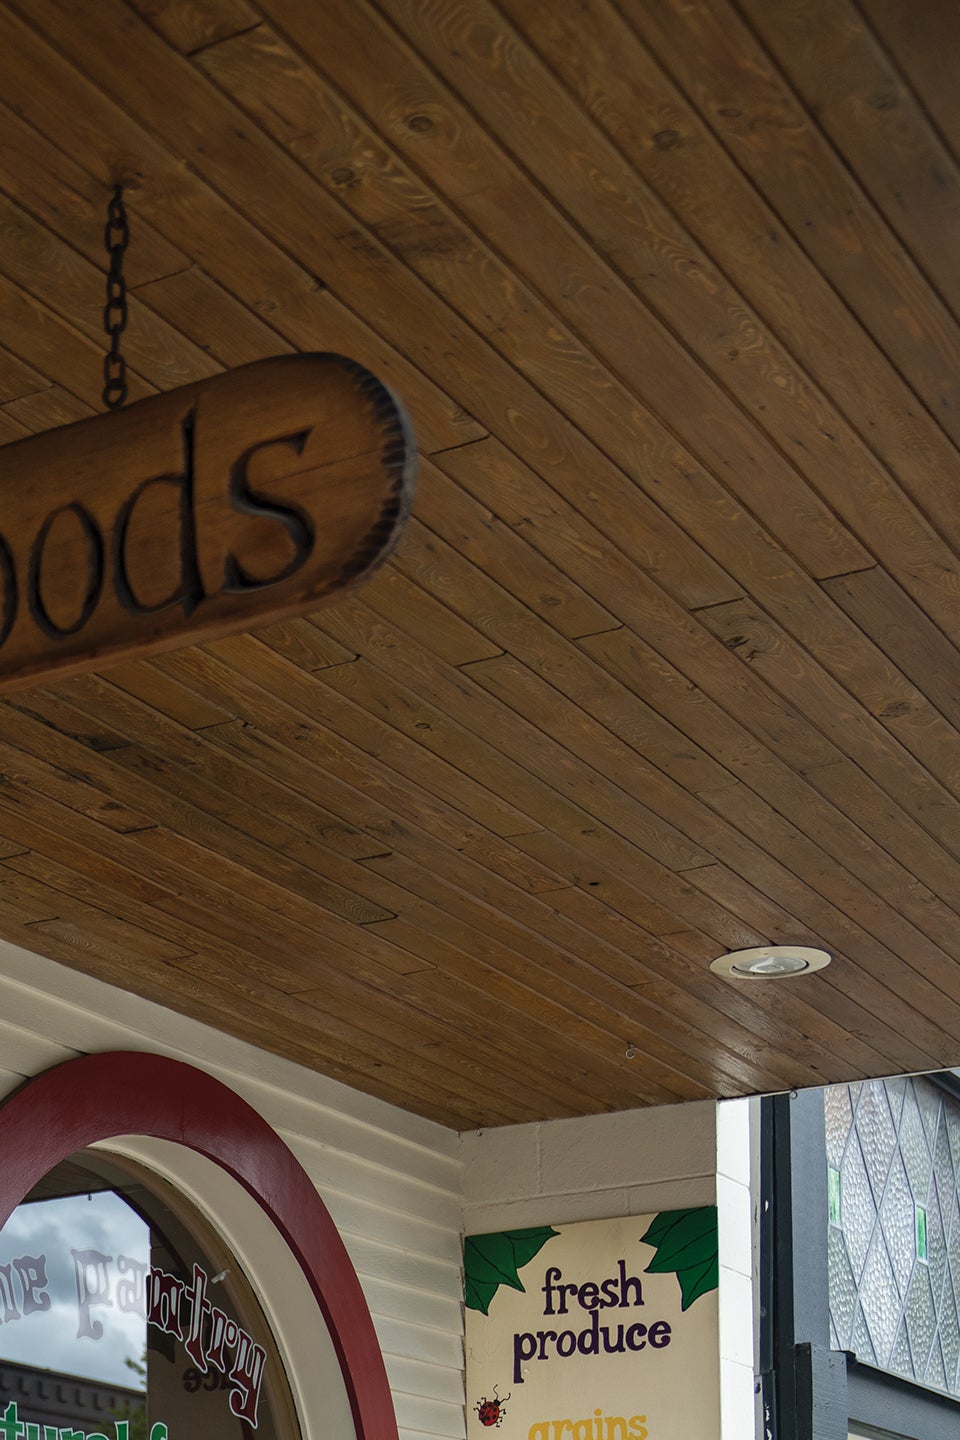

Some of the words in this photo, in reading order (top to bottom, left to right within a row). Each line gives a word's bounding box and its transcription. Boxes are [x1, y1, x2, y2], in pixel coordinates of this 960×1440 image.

[542, 1260, 645, 1316] fresh
[70, 1248, 267, 1430] pantry
[513, 1310, 672, 1384] produce
